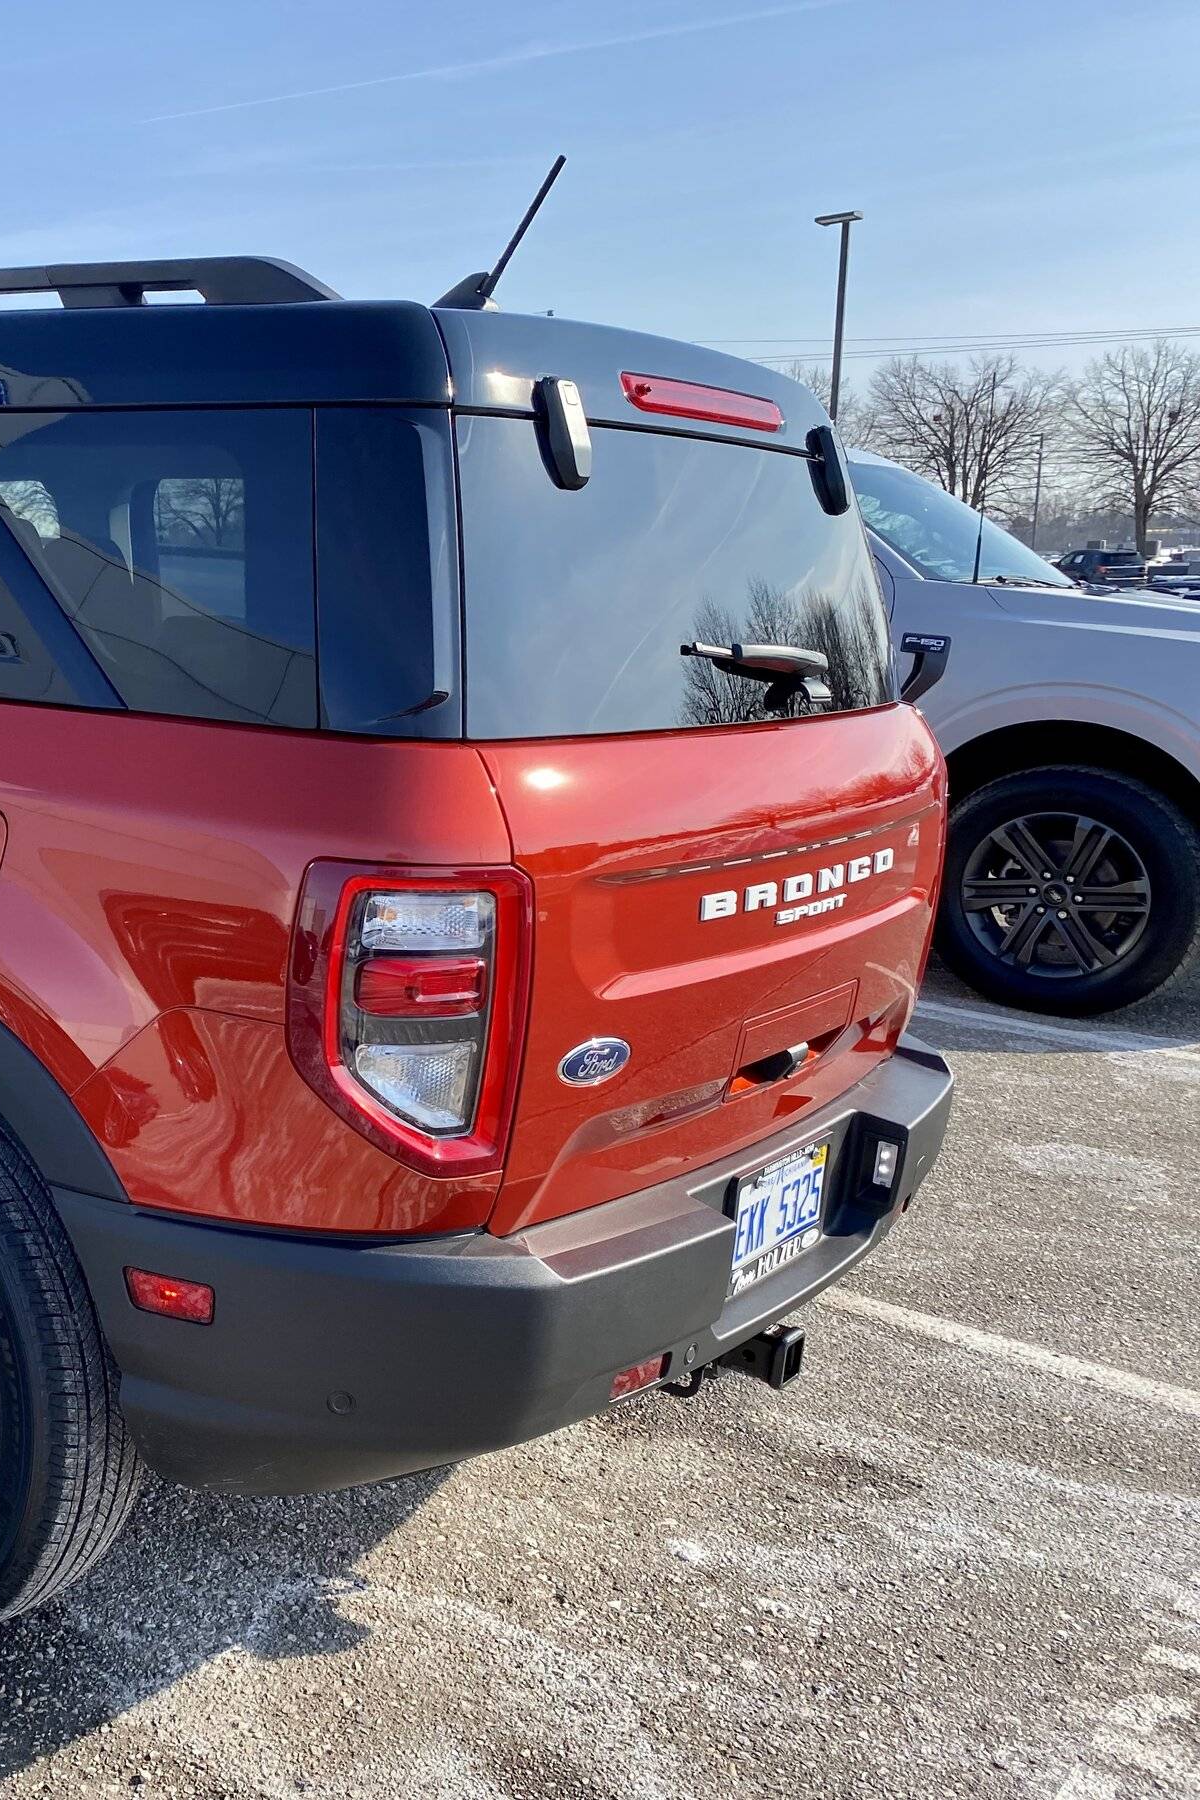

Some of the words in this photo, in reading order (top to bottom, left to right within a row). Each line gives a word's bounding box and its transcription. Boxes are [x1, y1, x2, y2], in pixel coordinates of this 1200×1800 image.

[701, 847, 894, 921] BRONCO
[775, 893, 848, 925] SPORT
[578, 1048, 618, 1077] Ford
[735, 1194, 770, 1262] EKK
[777, 1169, 823, 1235] 5325
[757, 1236, 801, 1277] HOLZER
